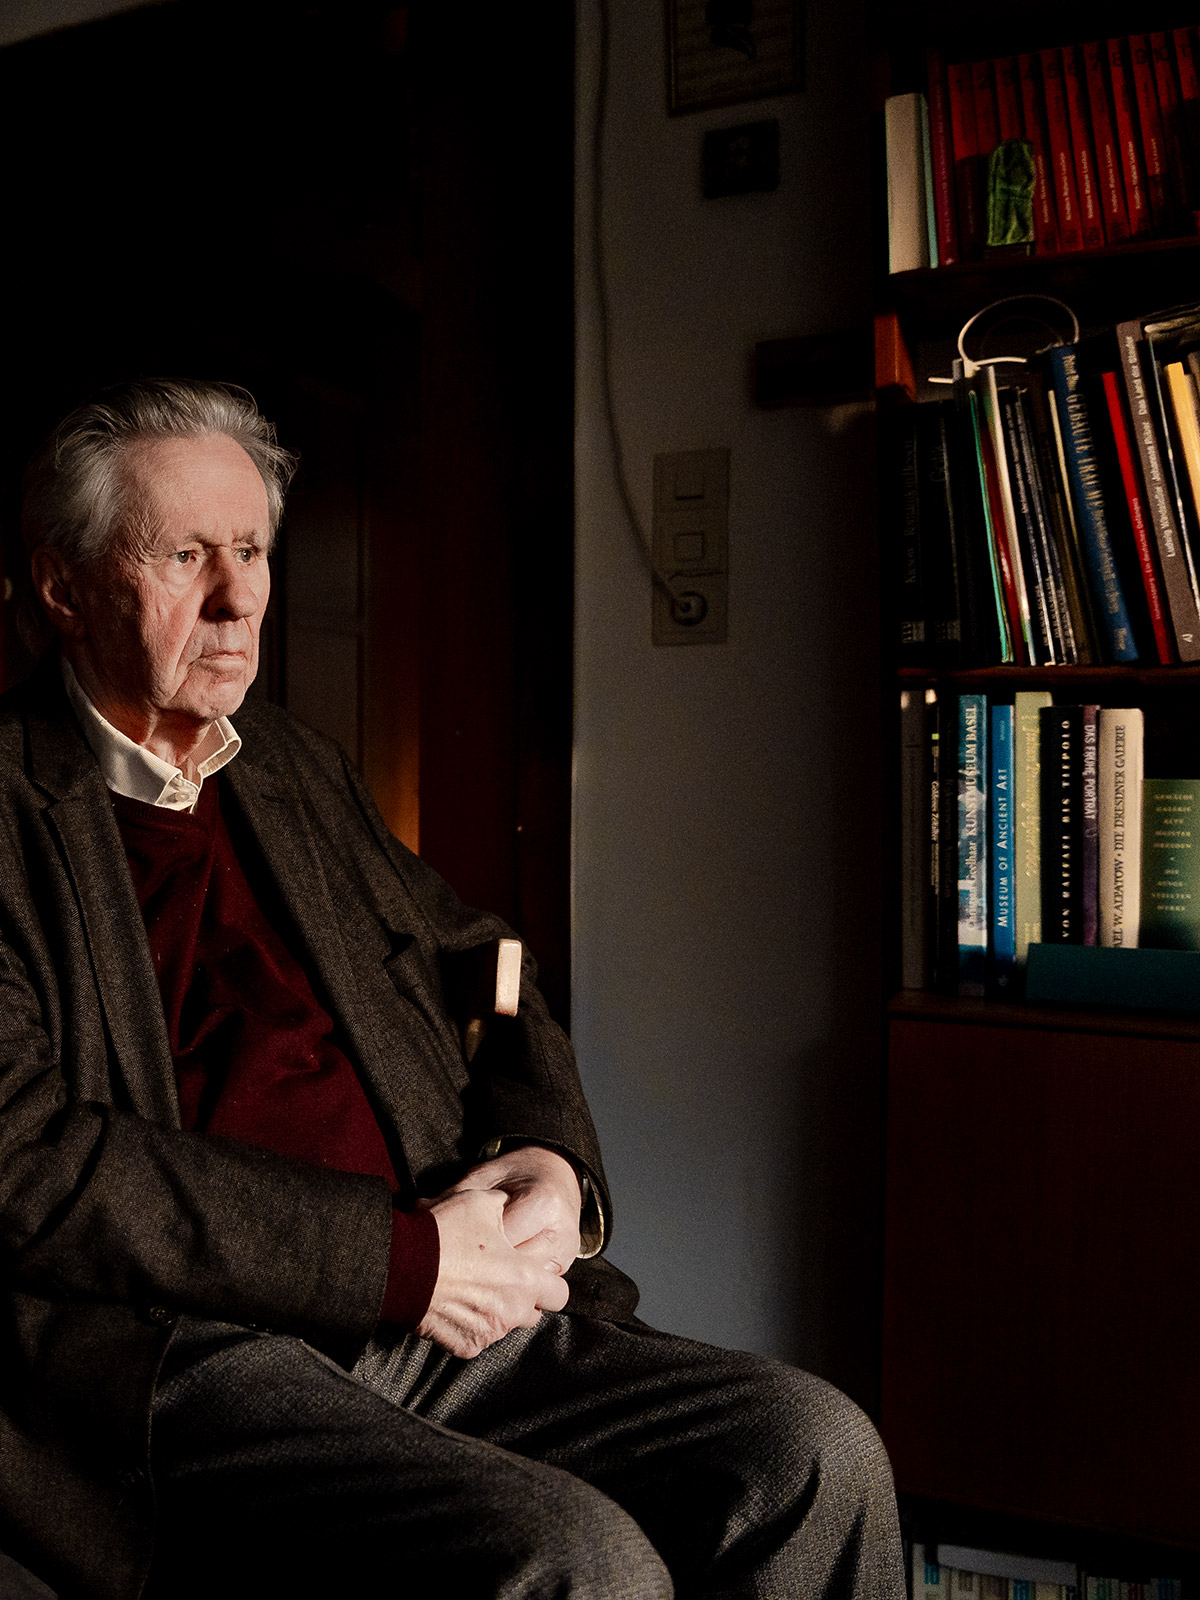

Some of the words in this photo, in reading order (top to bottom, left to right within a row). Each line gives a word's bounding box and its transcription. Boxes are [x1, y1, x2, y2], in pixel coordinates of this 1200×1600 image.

[1130, 365, 1141, 378] der
[1132, 378, 1144, 398] Land
[1065, 393, 1096, 453] GEBAUTE
[1136, 399, 1147, 416] Das
[1146, 445, 1161, 481] Johannes
[1159, 528, 1176, 557] Ludwig
[965, 704, 978, 741] BASEL
[1084, 724, 1097, 742] DAS
[1060, 720, 1072, 788] TIEPOLO
[1114, 725, 1125, 768] GALERIE
[965, 743, 978, 836] KUNSTMUSEUM
[996, 768, 1008, 790] ART
[1060, 797, 1072, 824] BIS
[1114, 770, 1125, 828] DRESDNER
[996, 797, 1008, 850] ANCIENT
[1114, 832, 1125, 850] DIE
[965, 841, 978, 883] Geelhaar
[1060, 835, 1072, 898] RAFFAEL
[1113, 859, 1125, 911] ALPATOW
[966, 885, 978, 930] Christian
[1060, 907, 1072, 938] VON
[1113, 911, 1124, 926] W.
